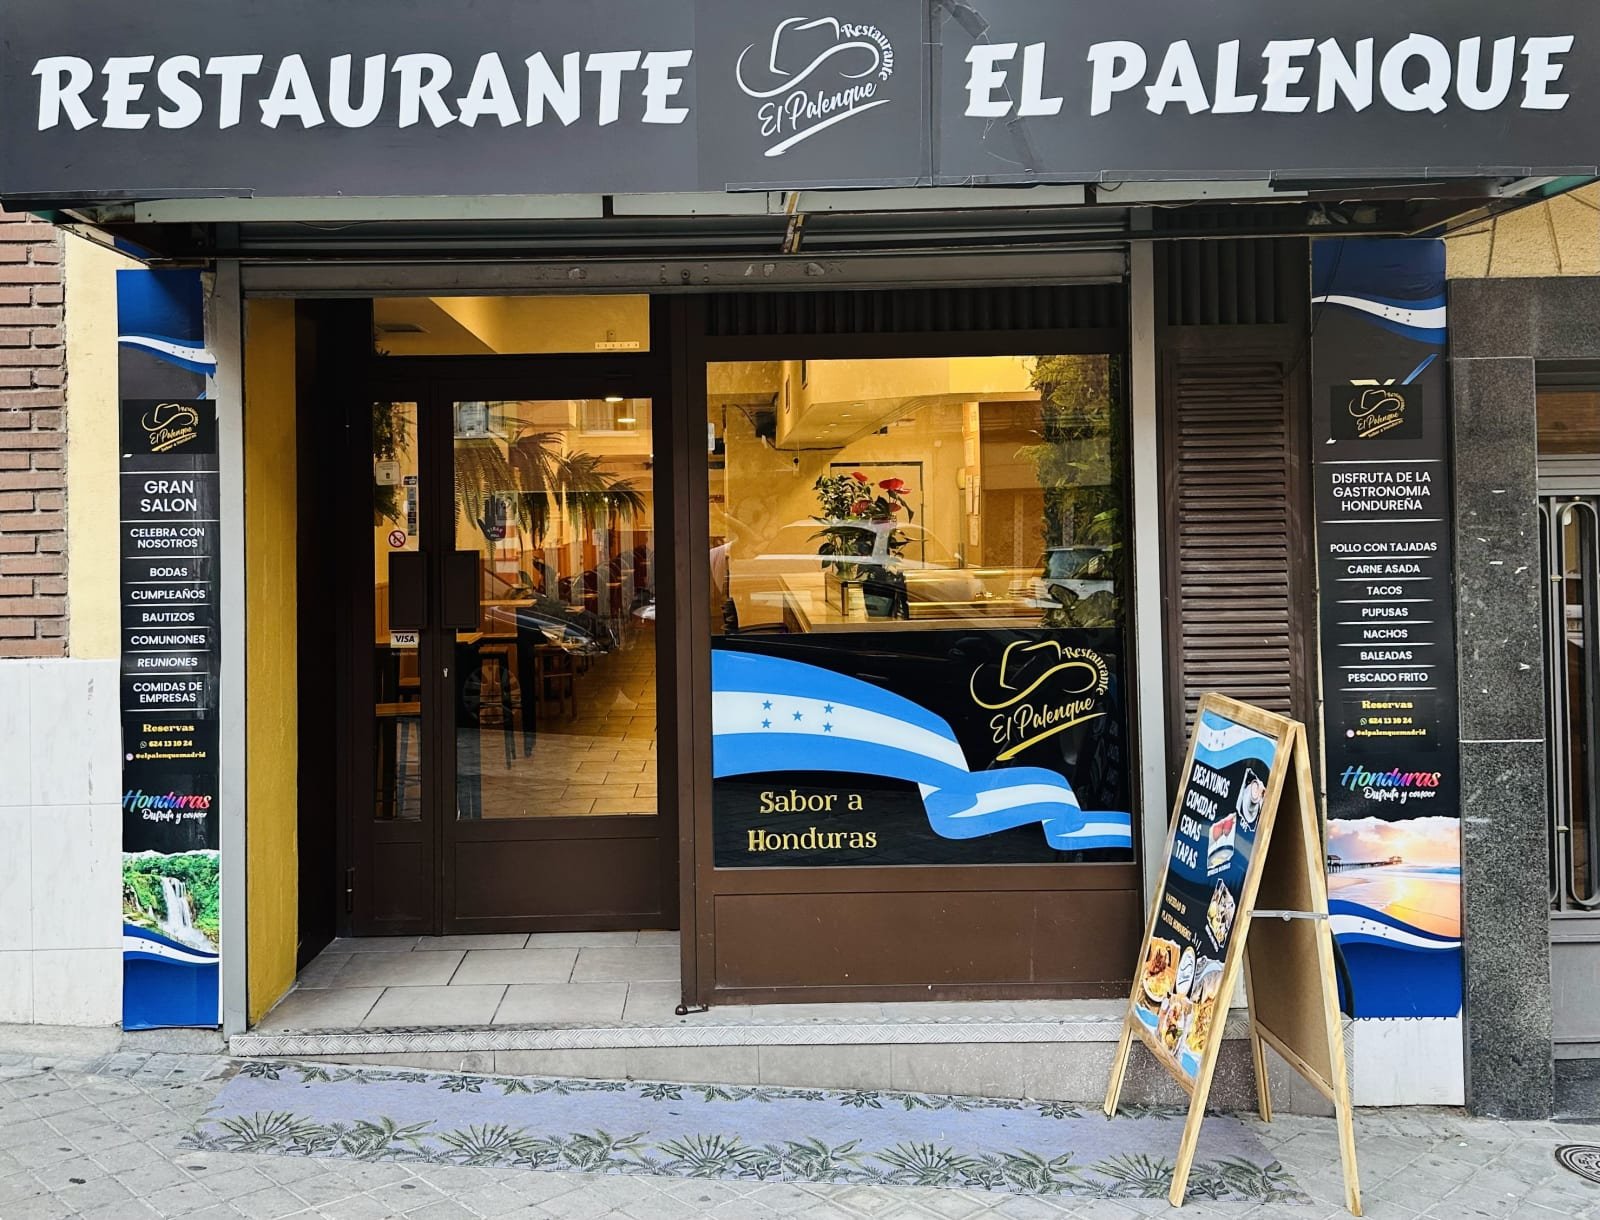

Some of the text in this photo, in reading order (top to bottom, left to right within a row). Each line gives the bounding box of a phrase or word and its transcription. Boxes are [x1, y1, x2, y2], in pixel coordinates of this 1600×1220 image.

[840, 23, 894, 81] Restaurante
[964, 33, 1575, 118] EL PALENQUE
[31, 50, 693, 131] RESTAURANTE
[757, 82, 877, 137] El Palenque
[1332, 471, 1431, 484] DISFRUTA DE LA
[144, 480, 194, 494] GRAN
[1333, 485, 1431, 498] GASTRONOMIA
[140, 498, 197, 513] SALON
[1341, 497, 1423, 511] HONDUREÑA
[130, 527, 205, 538] CELEBRA CON
[137, 539, 198, 549] NOSOTROS
[1330, 542, 1438, 553] POLLO CON TAJADAS
[149, 567, 188, 577] BODAS
[1347, 564, 1421, 574] CARNE ASADA
[131, 588, 206, 600] CUMPLEAÑOS
[1366, 586, 1403, 595] TACOS
[142, 612, 196, 622] BAUTIZOS
[1362, 607, 1409, 617] PUPUSAS
[130, 634, 206, 645] COMUNIONES
[395, 635, 415, 643] VISA
[1363, 629, 1408, 639] NACHOS
[137, 657, 198, 667] REUNIONES
[1360, 651, 1413, 660] BALEADAS
[1062, 646, 1109, 696] Restaurante
[1347, 672, 1428, 682] PESCADO FRITO
[132, 681, 203, 692] COMIDAS DE
[139, 693, 197, 703] EMPRESAS
[1361, 700, 1414, 709] Reservas
[989, 697, 1095, 744] El Palenque
[142, 723, 195, 733] Reservas
[148, 740, 163, 748] 624
[1192, 764, 1231, 798] DESAYUNOS
[1340, 765, 1441, 791] Honduras
[121, 789, 212, 813] Honduras
[759, 789, 864, 814] Sabor a
[1400, 790, 1407, 805] y
[1186, 789, 1218, 821] COMIDAS
[175, 812, 182, 825] y
[1180, 814, 1202, 842] CENAS
[747, 826, 878, 852] Honduras
[1175, 840, 1198, 869] TAPAS
